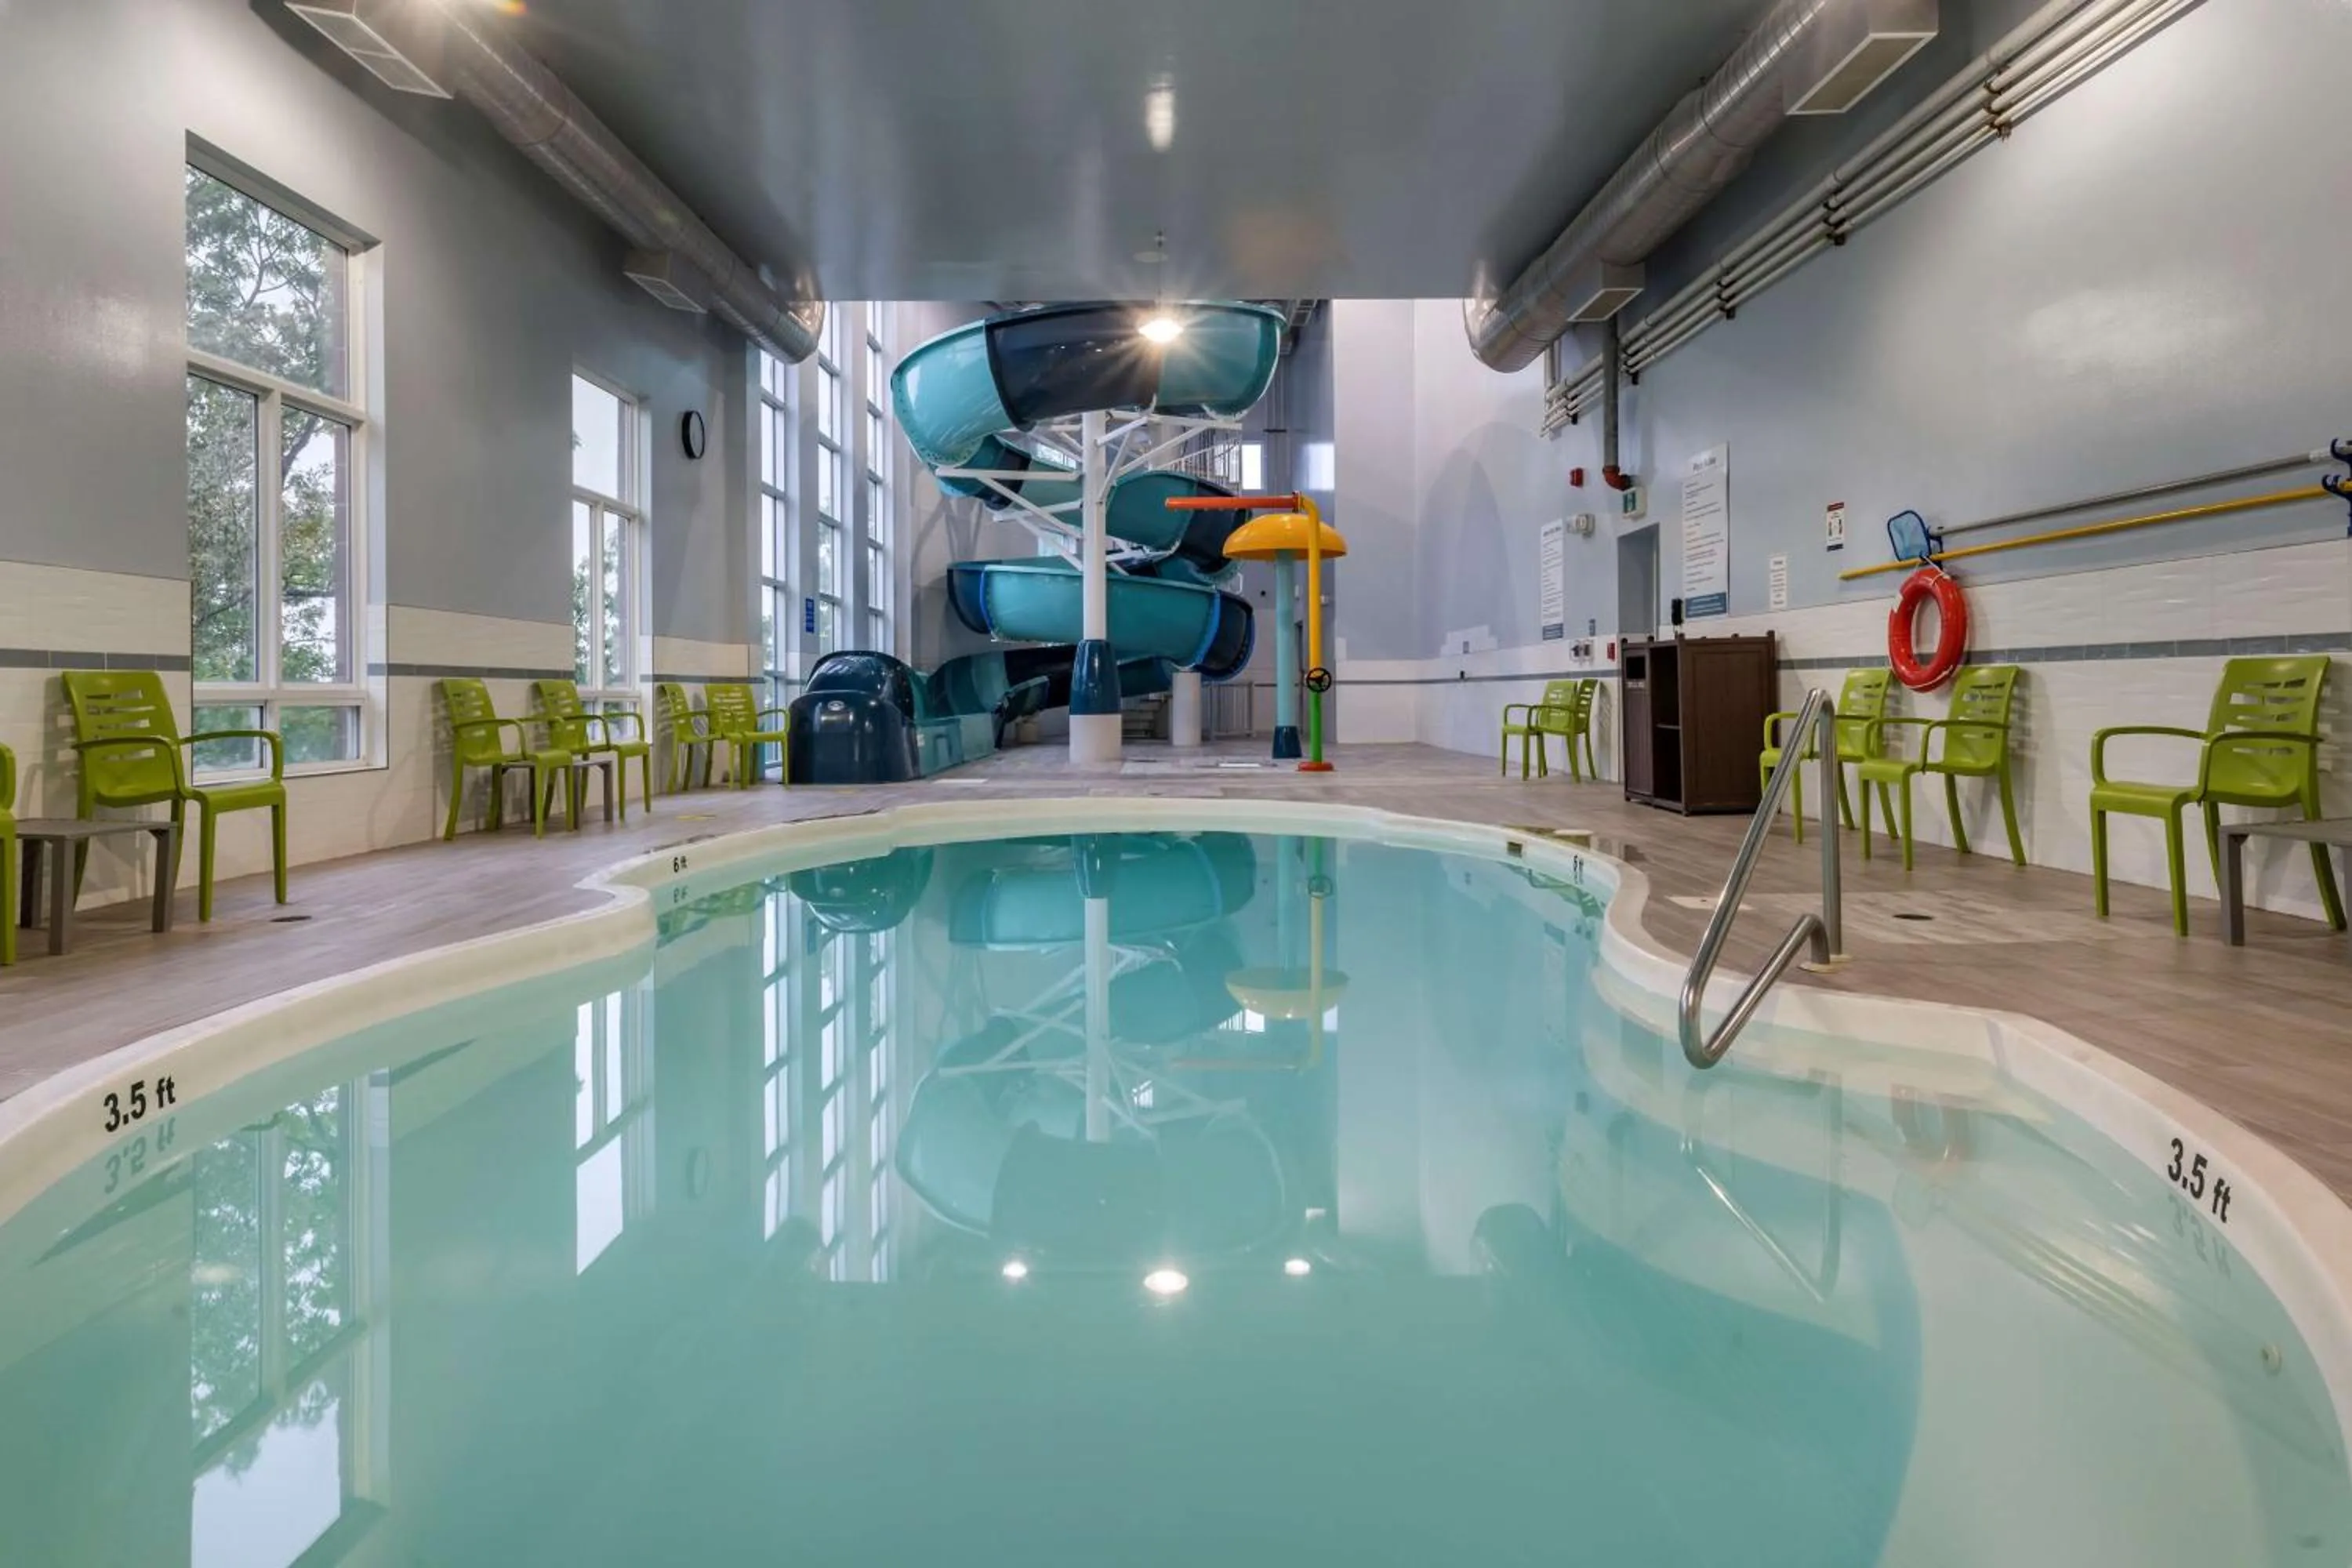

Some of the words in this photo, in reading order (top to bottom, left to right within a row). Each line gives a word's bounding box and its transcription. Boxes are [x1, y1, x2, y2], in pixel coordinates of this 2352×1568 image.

[673, 857, 679, 873] 6
[103, 1080, 147, 1132] 3.5
[156, 1076, 176, 1109] ft
[2168, 1138, 2208, 1200] 3.5
[2212, 1178, 2230, 1223] ft
